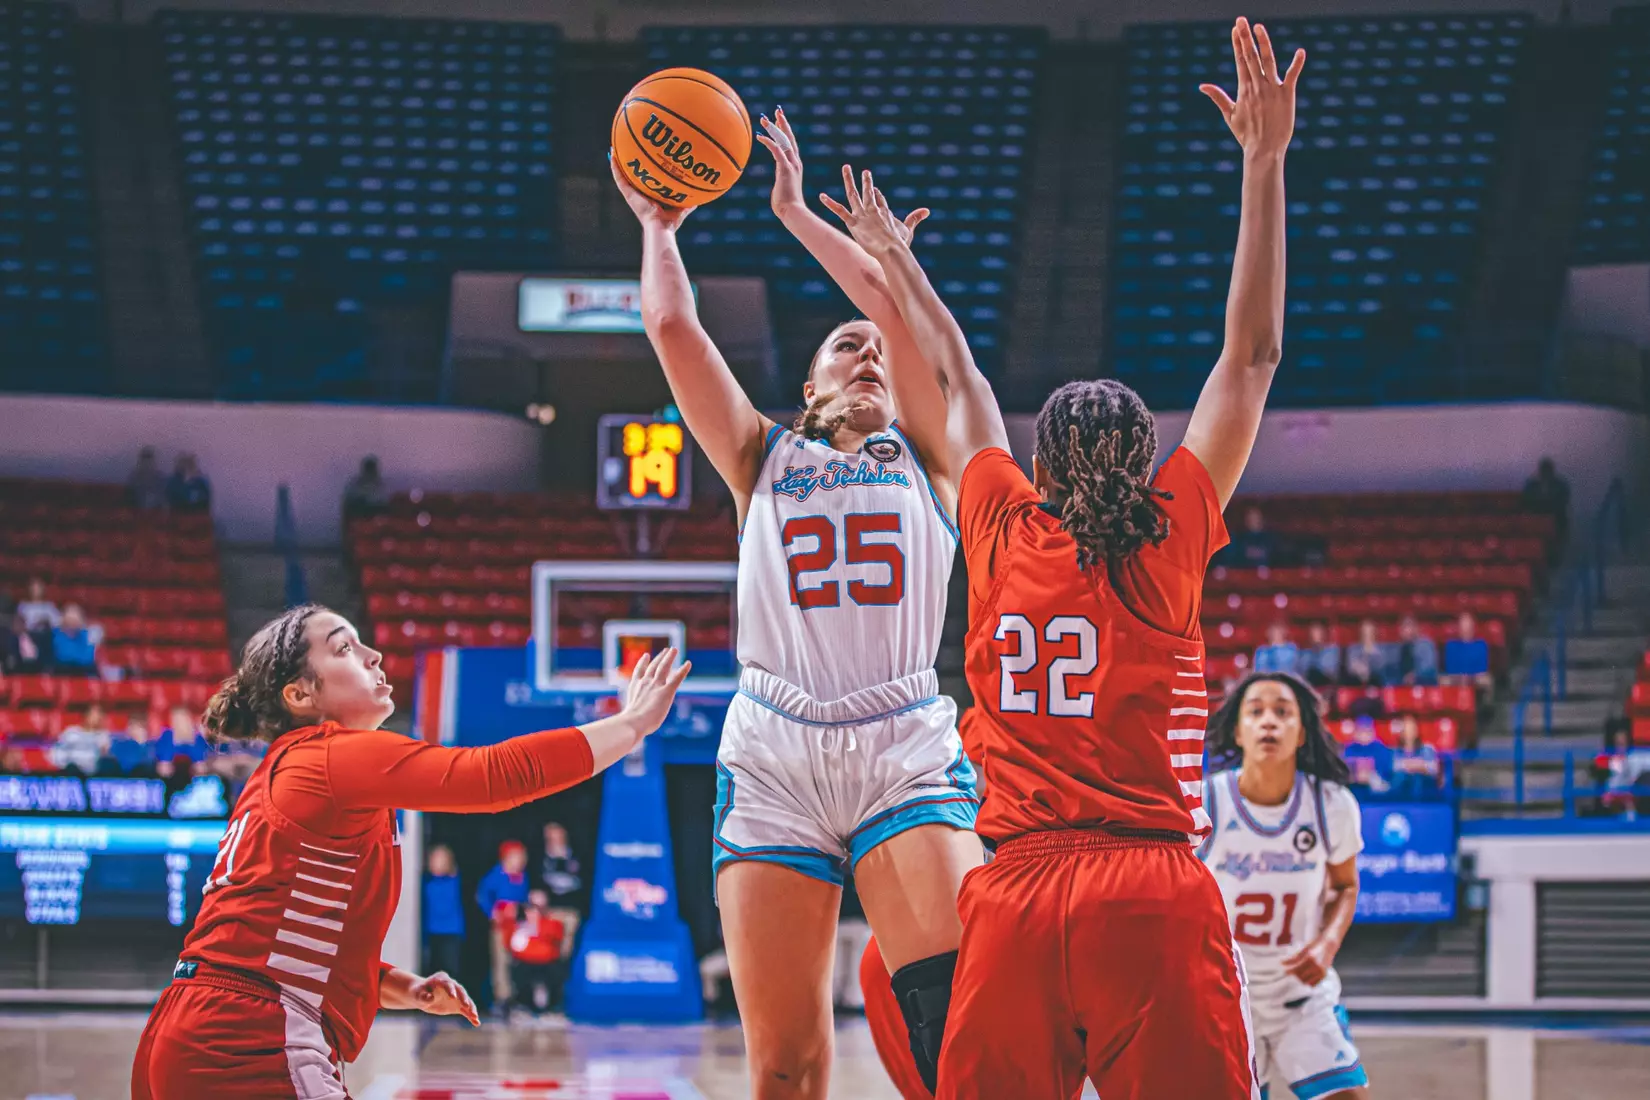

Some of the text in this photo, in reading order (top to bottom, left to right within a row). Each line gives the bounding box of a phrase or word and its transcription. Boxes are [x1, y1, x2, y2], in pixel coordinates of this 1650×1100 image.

[626, 158, 688, 203] NCAA
[642, 113, 721, 186] Wilson
[772, 465, 819, 502] Lady
[782, 512, 905, 610] 25
[993, 613, 1099, 719] 22
[1233, 893, 1298, 946] 21
